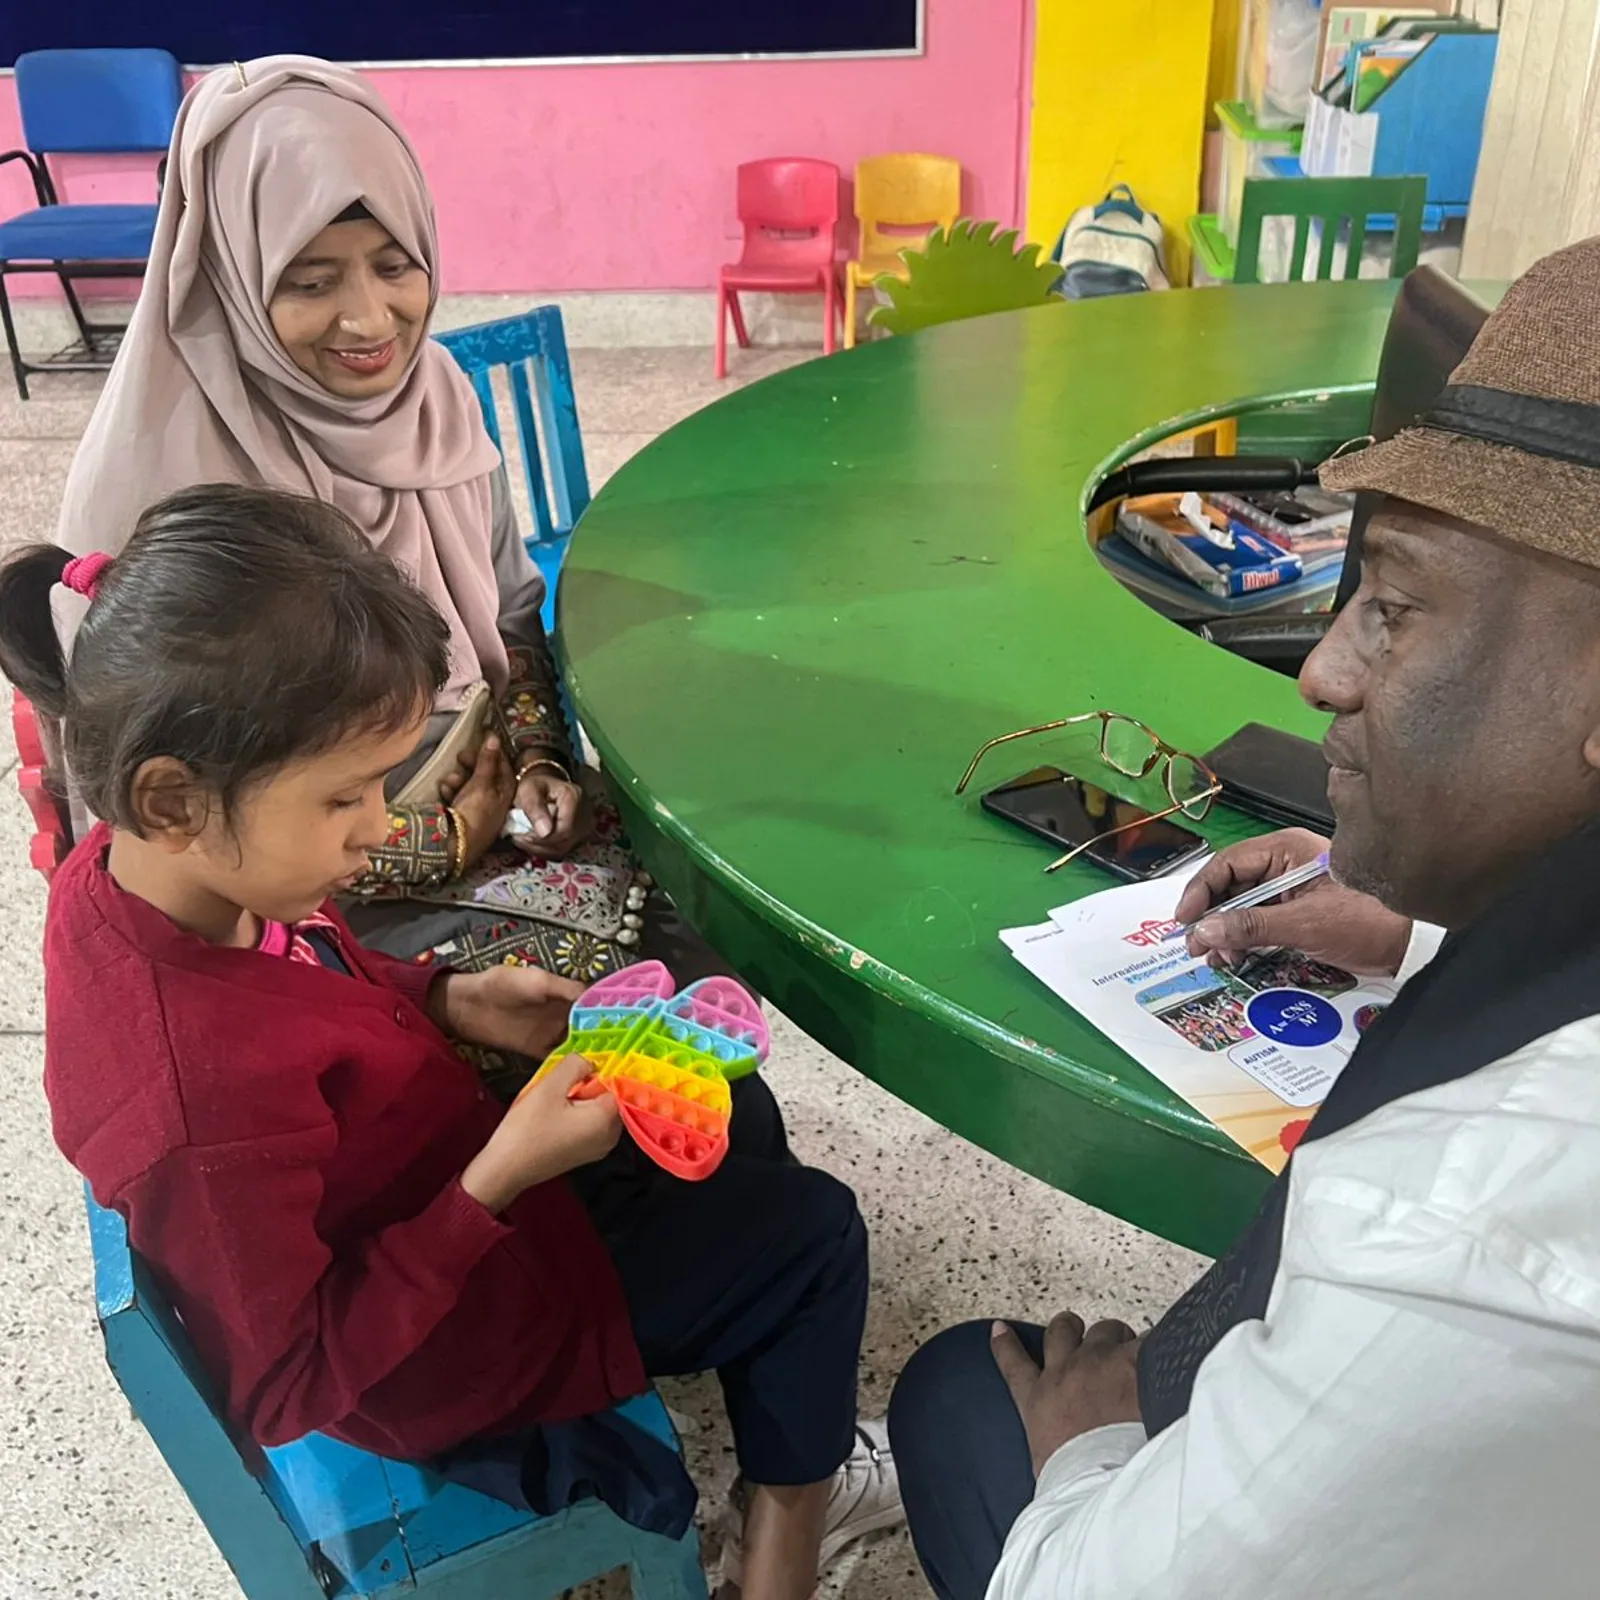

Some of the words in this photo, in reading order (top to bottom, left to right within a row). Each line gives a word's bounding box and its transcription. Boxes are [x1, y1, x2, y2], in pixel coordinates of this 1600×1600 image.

[1091, 956, 1158, 987] International
[1280, 1000, 1312, 1019] CNS
[1243, 1045, 1279, 1065] AUTISM
